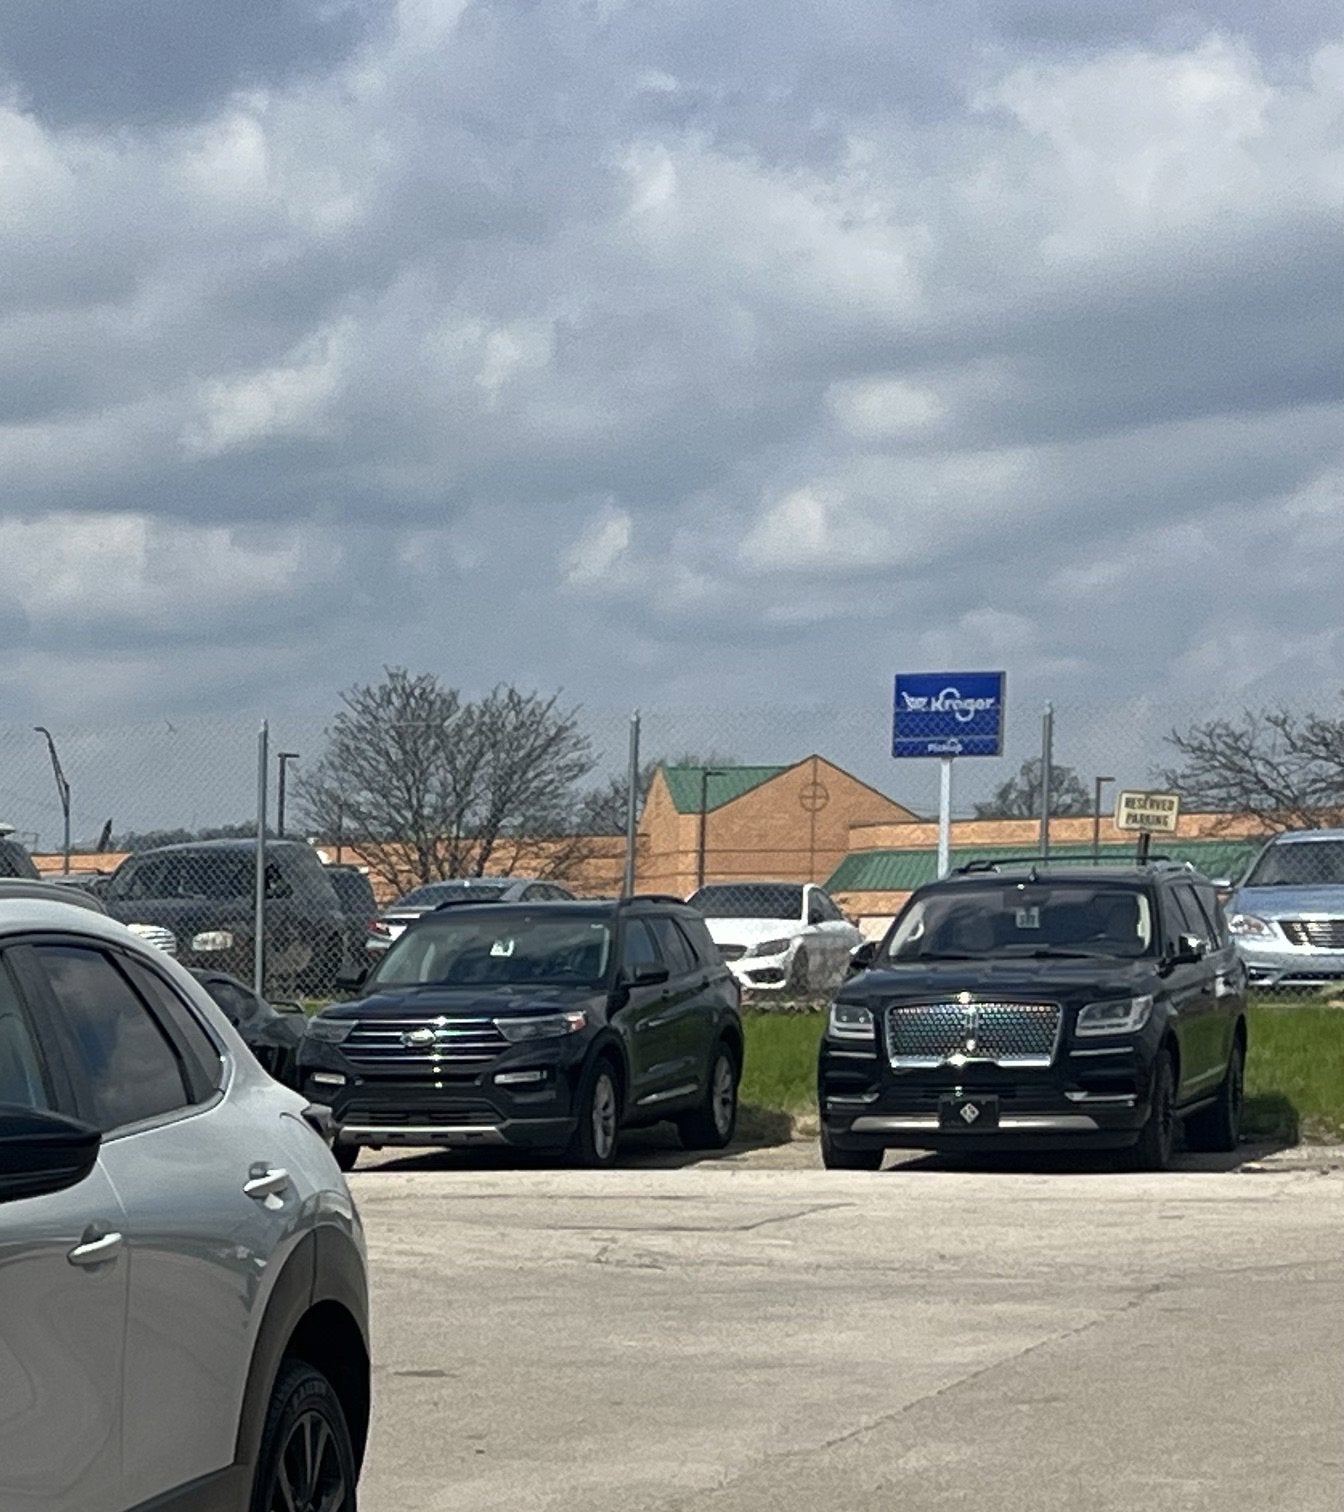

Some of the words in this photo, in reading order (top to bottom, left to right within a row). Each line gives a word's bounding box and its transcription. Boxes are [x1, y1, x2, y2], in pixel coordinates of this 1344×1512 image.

[931, 687, 995, 722] Kroger
[1125, 797, 1175, 811] RESERVED
[1126, 812, 1169, 827] PARKING
